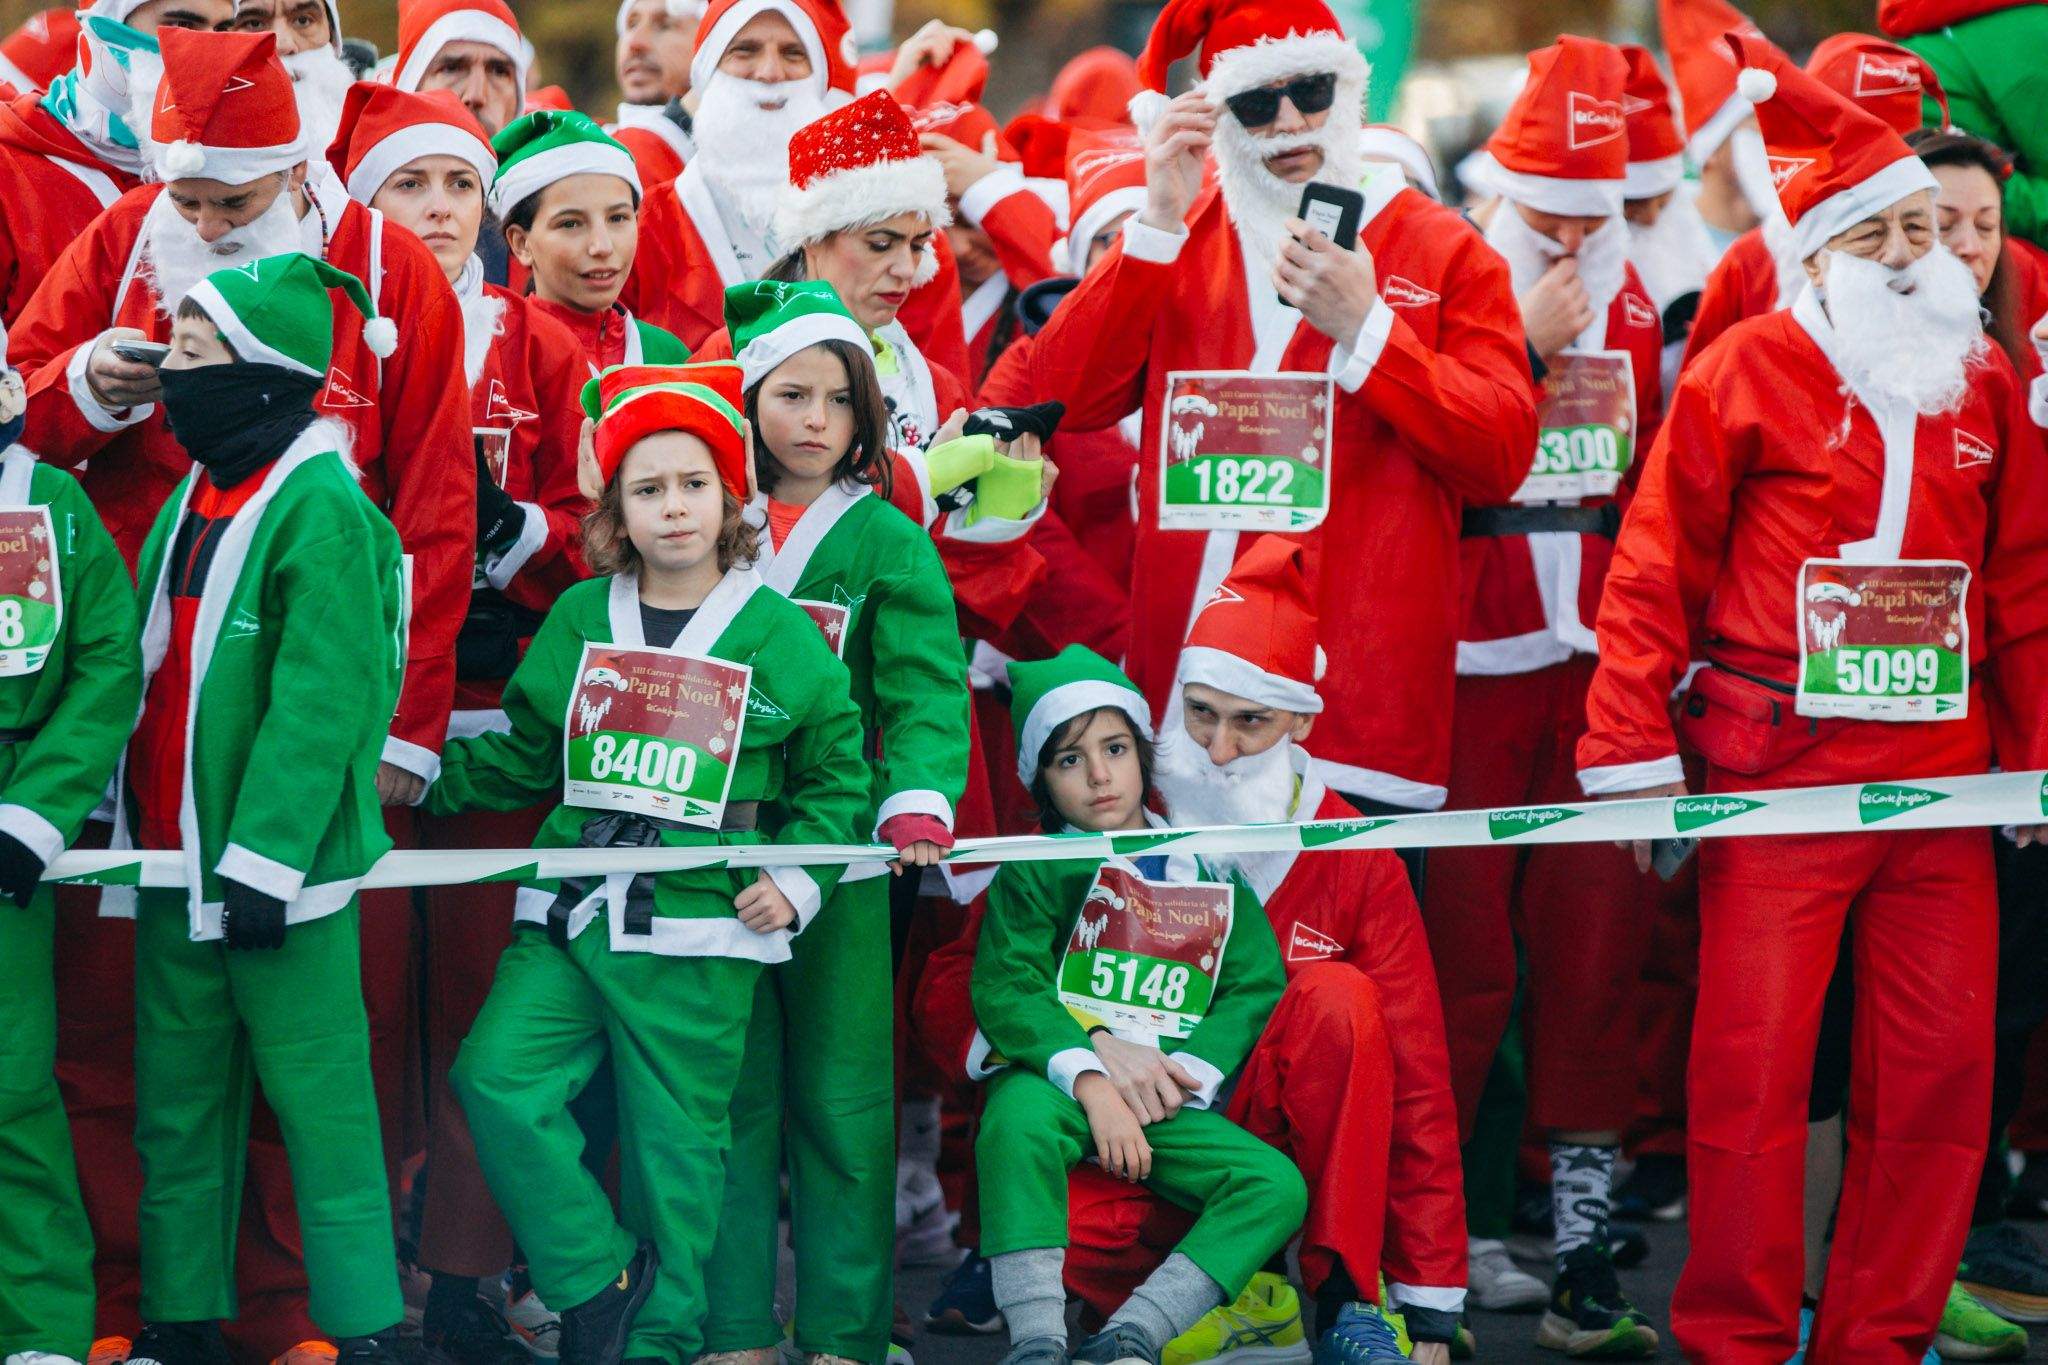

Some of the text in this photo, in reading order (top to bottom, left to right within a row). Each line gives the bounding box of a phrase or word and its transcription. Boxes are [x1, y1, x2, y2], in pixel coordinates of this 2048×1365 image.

[1217, 399, 1308, 422] Papá Noel
[1193, 459, 1294, 504] 1822
[484, 518, 504, 541] KIPRU
[0, 535, 28, 553] oel
[1861, 589, 1906, 612] Papá
[632, 666, 723, 689] XIII Carrera solidaria de
[1837, 648, 1939, 695] 5099
[625, 677, 721, 708] Papá Noel
[590, 735, 698, 793] 8400
[1687, 801, 1712, 813] Corte
[1711, 798, 1748, 816] Inglés
[1872, 792, 1896, 804] Corte
[1125, 896, 1210, 928] Papá Noel
[1091, 952, 1190, 1010] 5148
